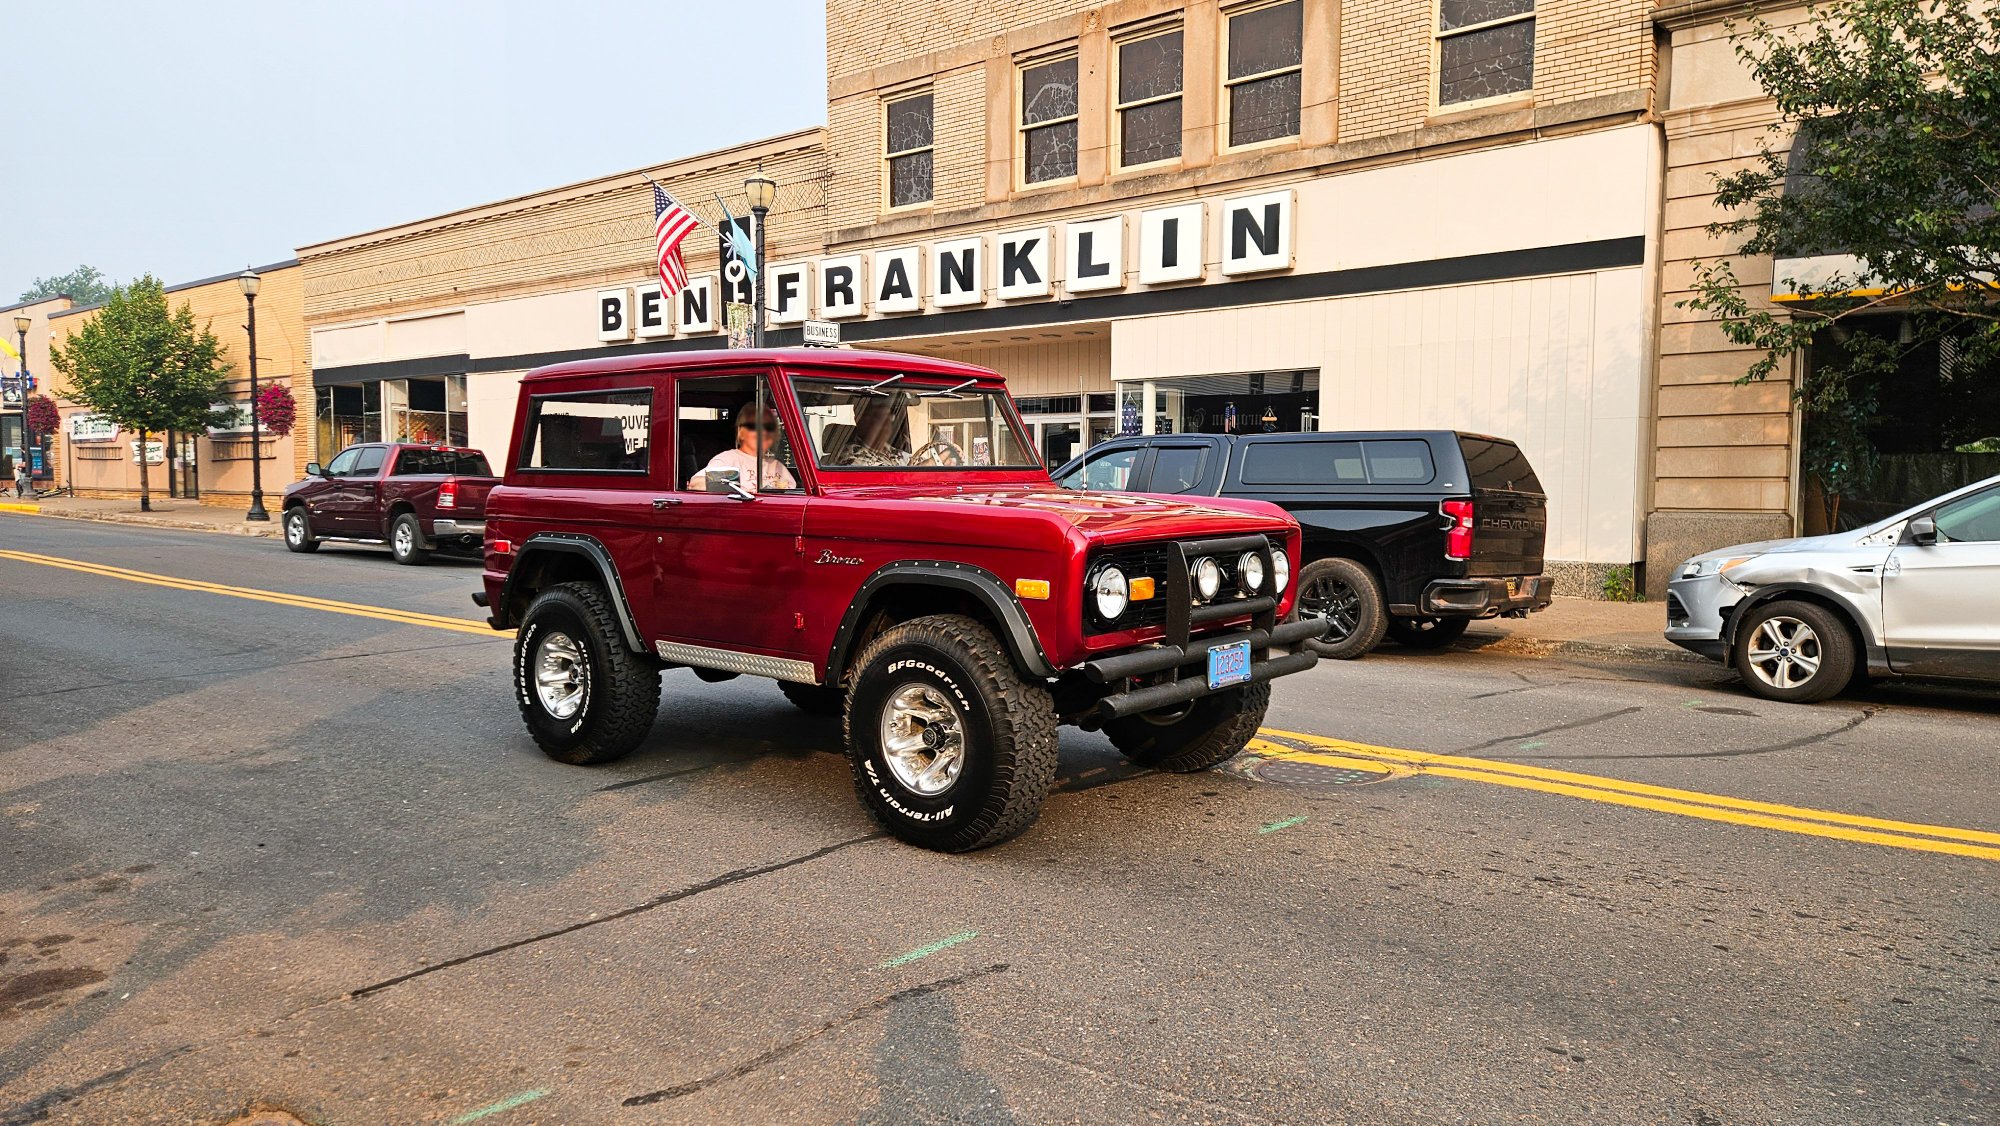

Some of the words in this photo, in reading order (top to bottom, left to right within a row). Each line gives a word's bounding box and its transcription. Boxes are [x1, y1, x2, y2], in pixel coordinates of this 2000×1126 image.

[602, 287, 708, 332] BEN
[777, 202, 1281, 316] FRANKLIN
[806, 325, 838, 339] BUSINESS
[615, 414, 649, 430] OUVE
[1481, 518, 1545, 530] CHEVROLET
[814, 549, 864, 565] Bronco
[1215, 651, 1244, 676] 123259
[887, 659, 970, 711] BFGoodrich
[864, 759, 881, 787] T/A
[879, 787, 954, 822] All-Terrain
